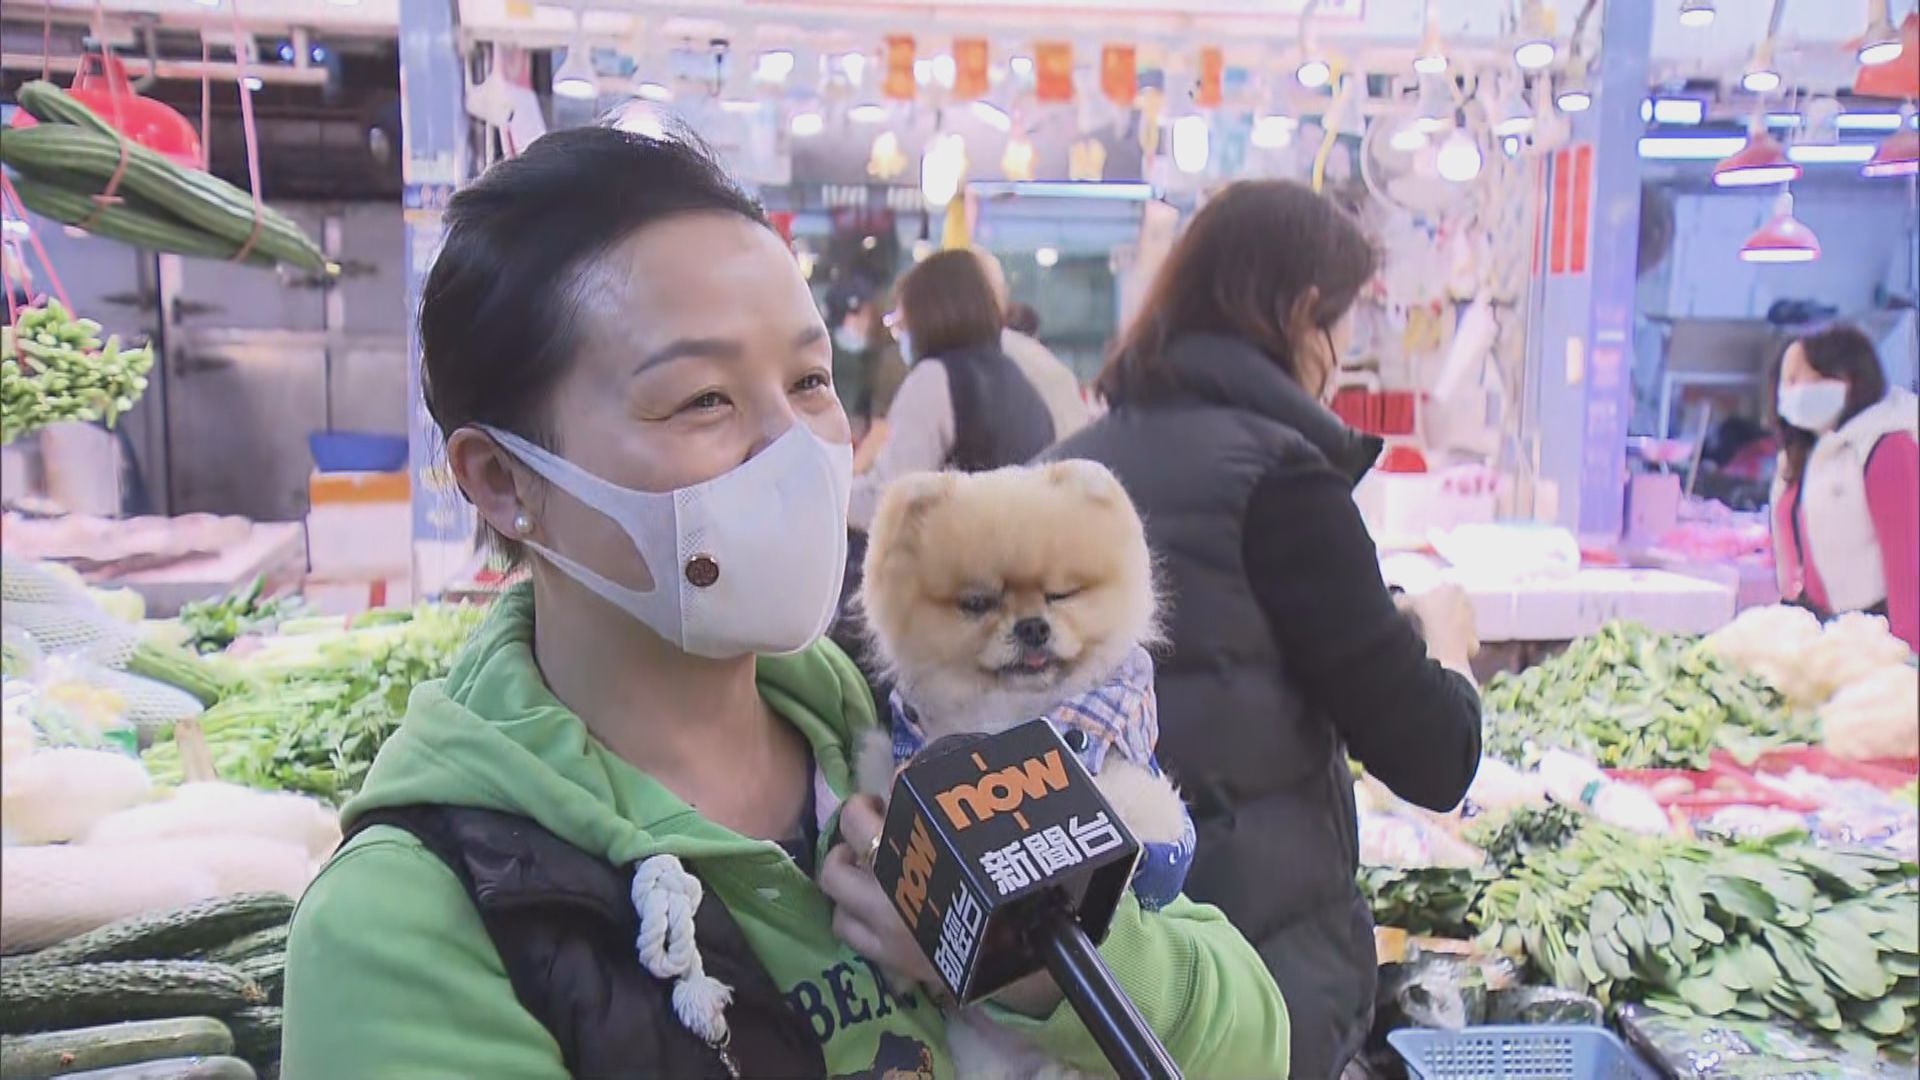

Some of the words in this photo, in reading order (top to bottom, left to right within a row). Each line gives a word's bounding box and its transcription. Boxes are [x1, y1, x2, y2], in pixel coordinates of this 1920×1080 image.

[935, 749, 1069, 831] now
[896, 812, 937, 929] now
[979, 811, 1123, 895] 新聞台
[934, 879, 982, 994] 財經台
